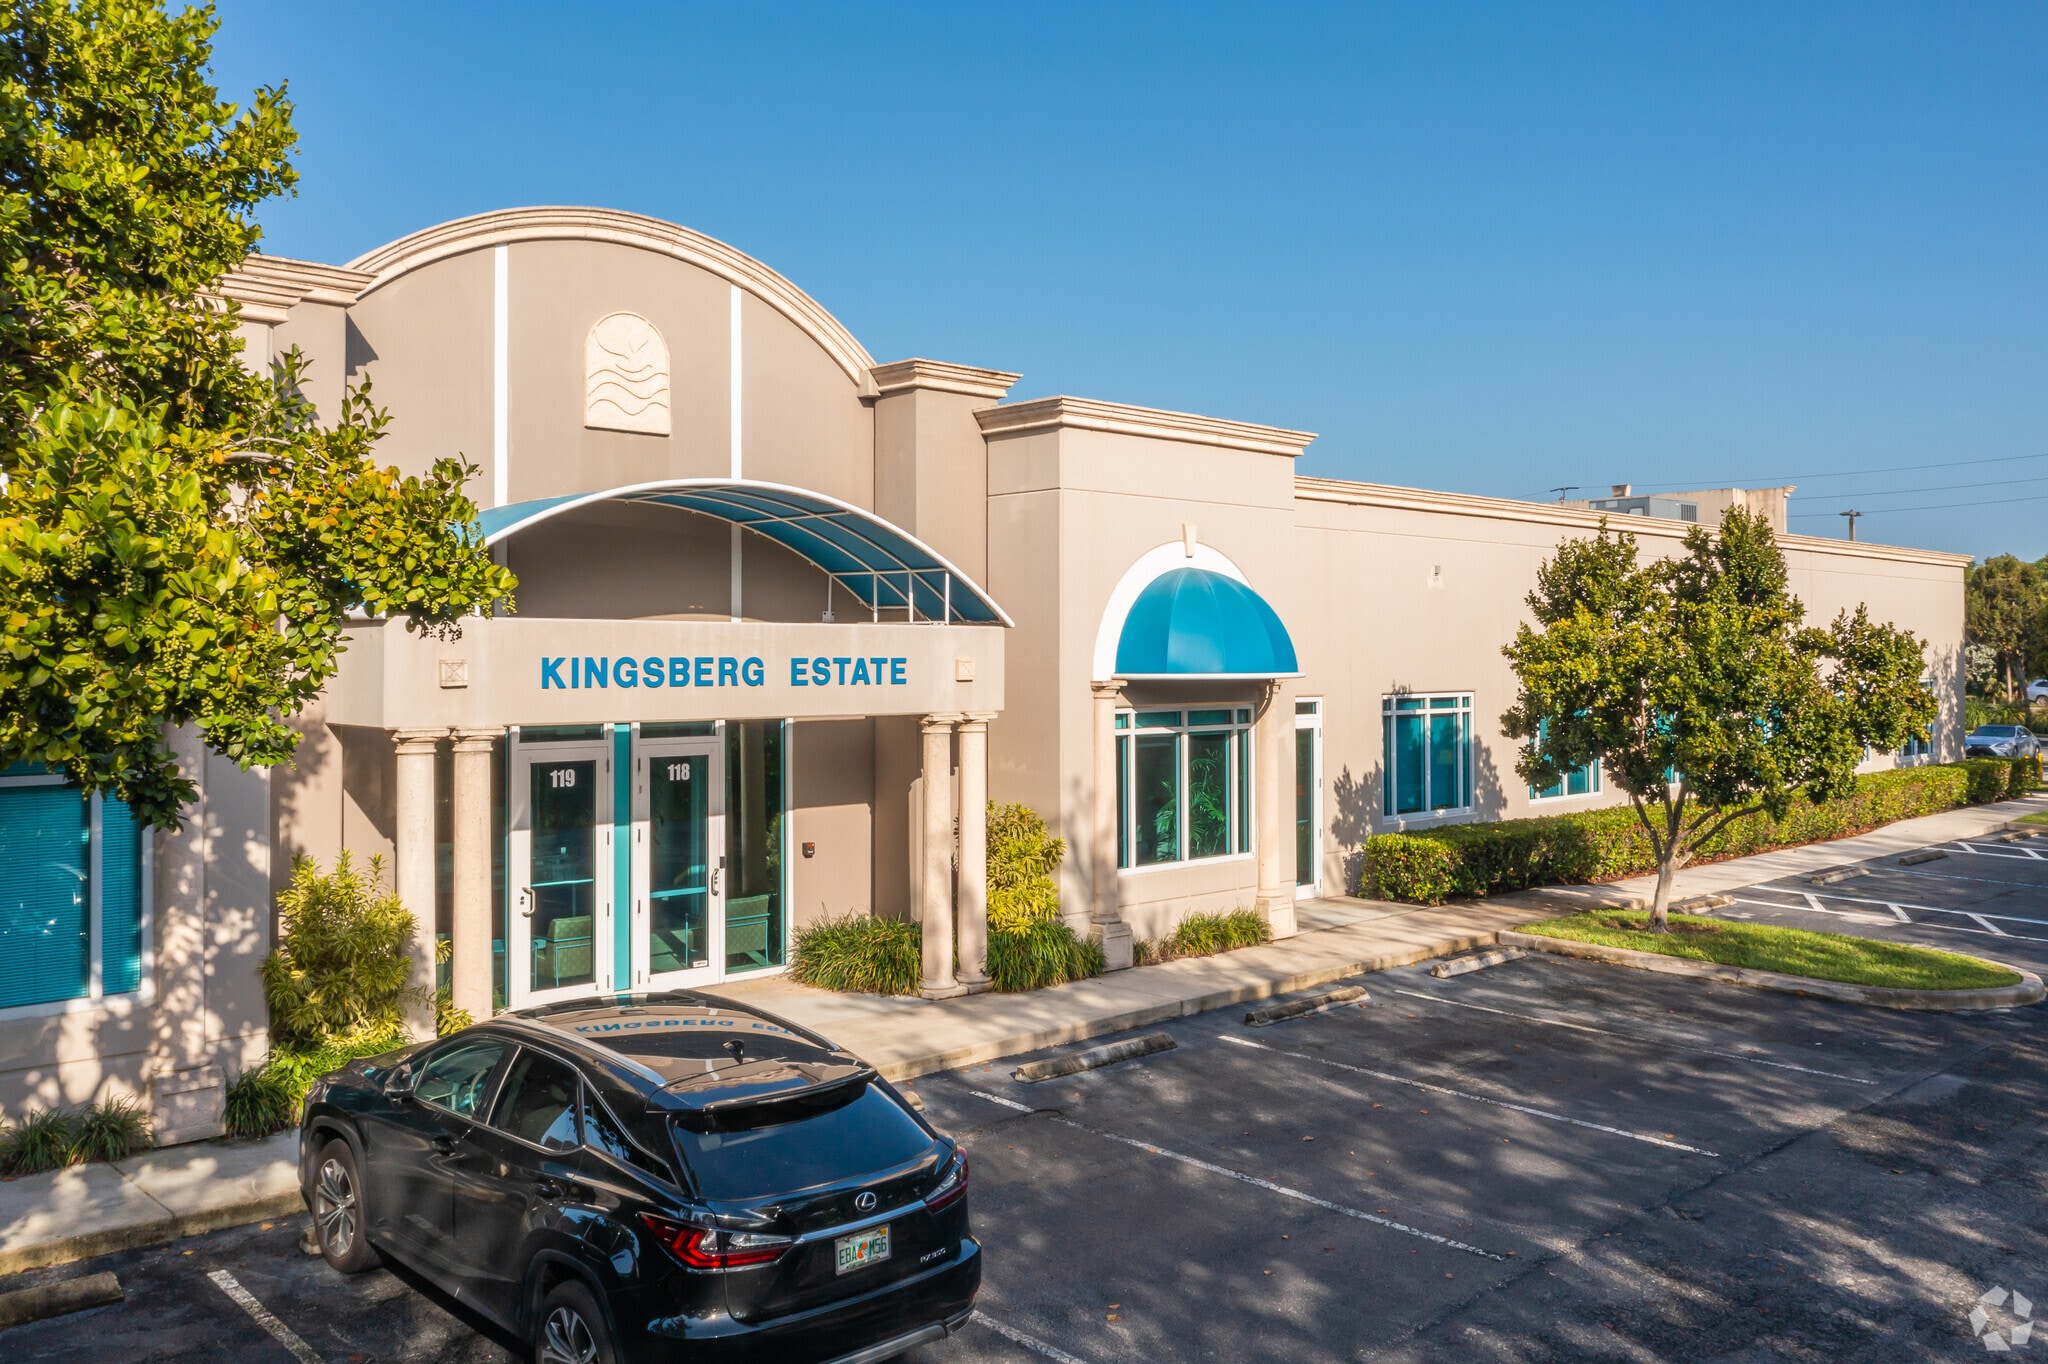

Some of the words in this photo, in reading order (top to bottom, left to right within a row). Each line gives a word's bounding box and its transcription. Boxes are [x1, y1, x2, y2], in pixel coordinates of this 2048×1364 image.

[541, 656, 765, 690] KINGSBERG
[790, 656, 908, 687] ESTATE
[550, 769, 576, 788] 119
[667, 763, 690, 781] 118
